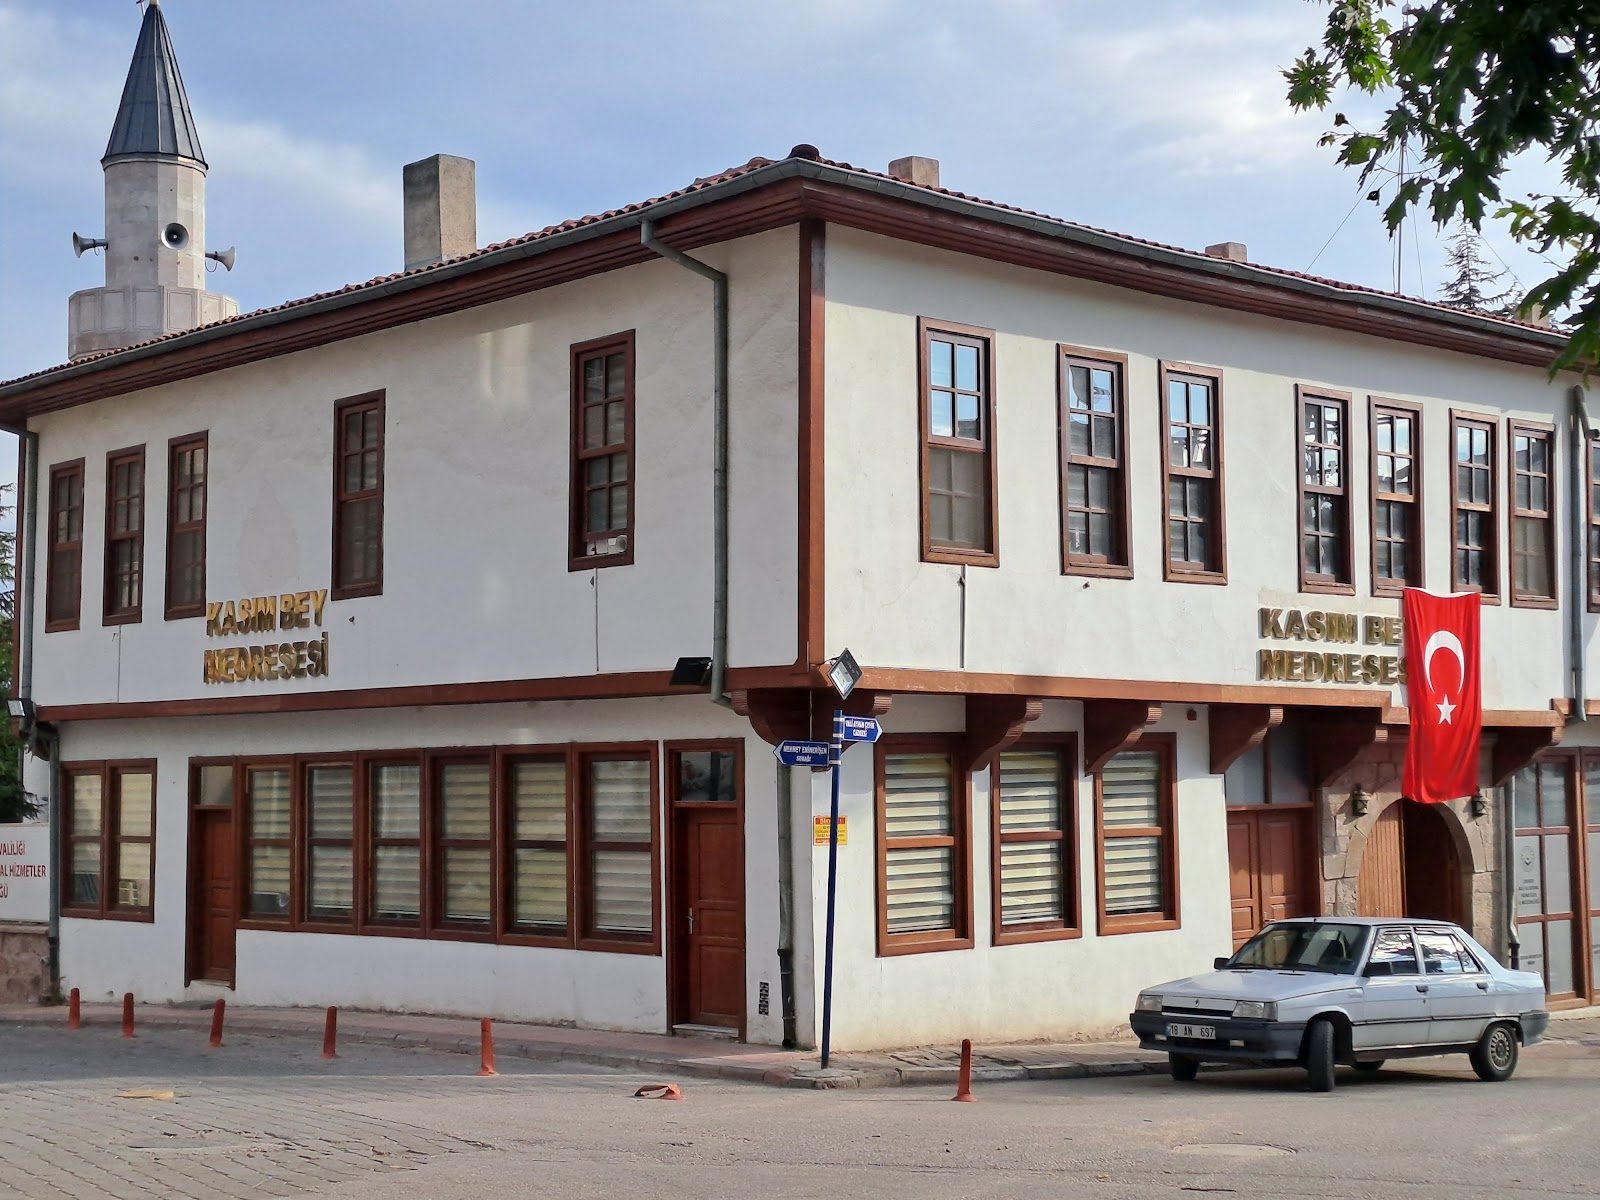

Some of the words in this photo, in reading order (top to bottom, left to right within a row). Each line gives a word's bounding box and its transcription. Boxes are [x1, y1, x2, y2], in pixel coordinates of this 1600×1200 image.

[206, 595, 277, 637] KASIM
[279, 588, 328, 630] BEY
[1258, 607, 1358, 644] KASIM
[1363, 614, 1405, 646] BE
[203, 631, 329, 684] MEDRESESİ
[1256, 648, 1409, 685] MEDRESES
[9, 862, 47, 878] HİZMETLER
[1184, 1025, 1193, 1036] AN
[1200, 1026, 1214, 1038] 697
